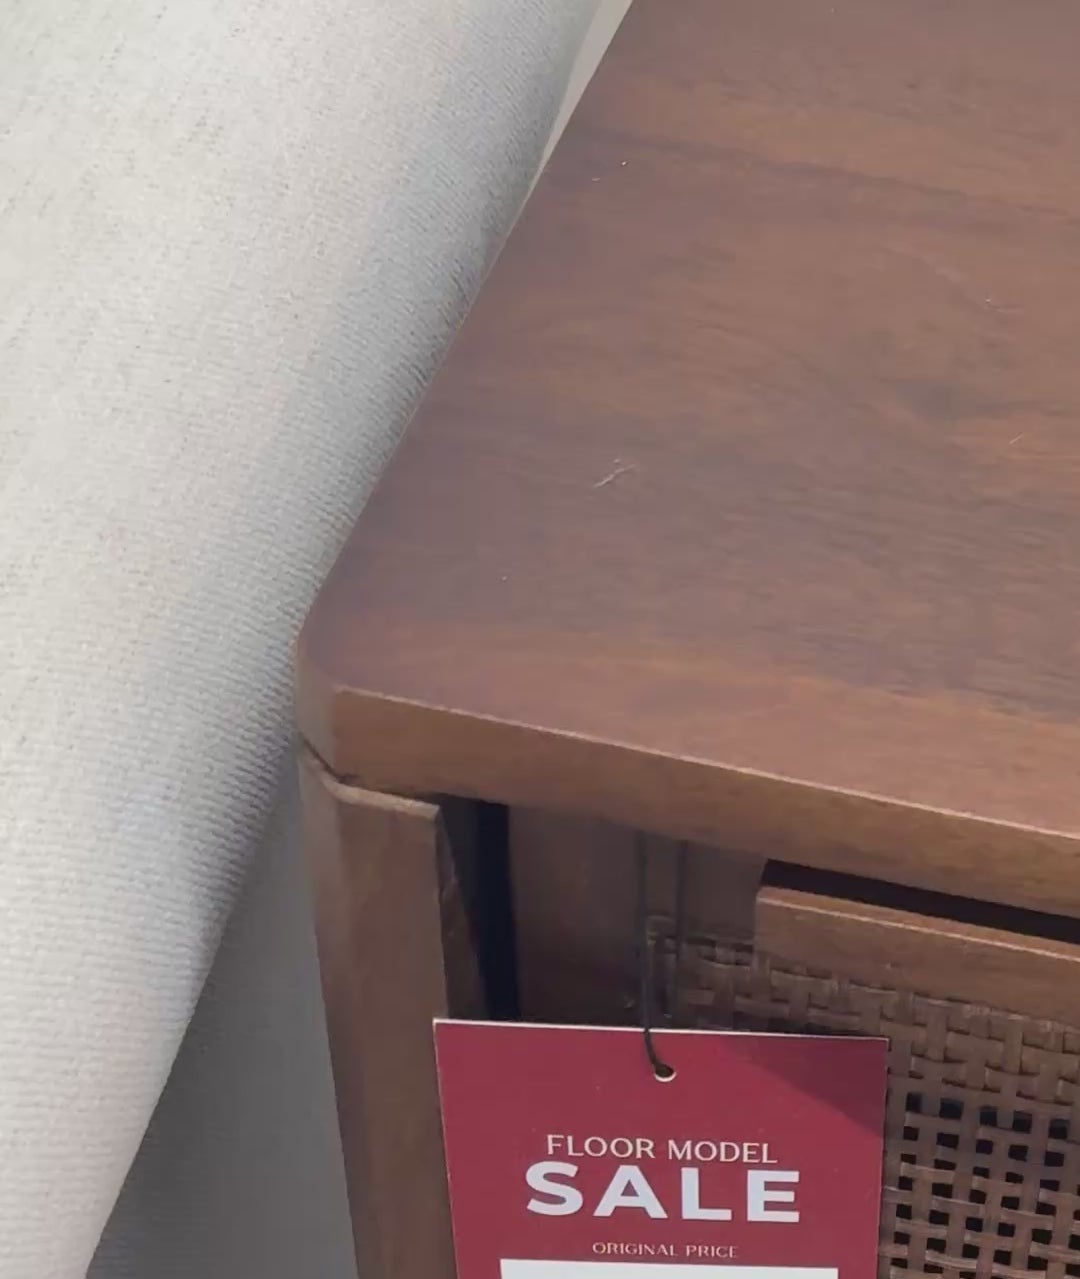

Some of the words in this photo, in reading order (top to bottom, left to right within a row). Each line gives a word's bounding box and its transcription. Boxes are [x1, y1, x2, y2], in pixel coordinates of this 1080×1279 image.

[547, 1134, 656, 1159] FLOOR
[667, 1139, 778, 1164] MODEL
[525, 1160, 800, 1223] SALE
[591, 1241, 678, 1257] ORIGINAL
[685, 1243, 738, 1259] PRICE
